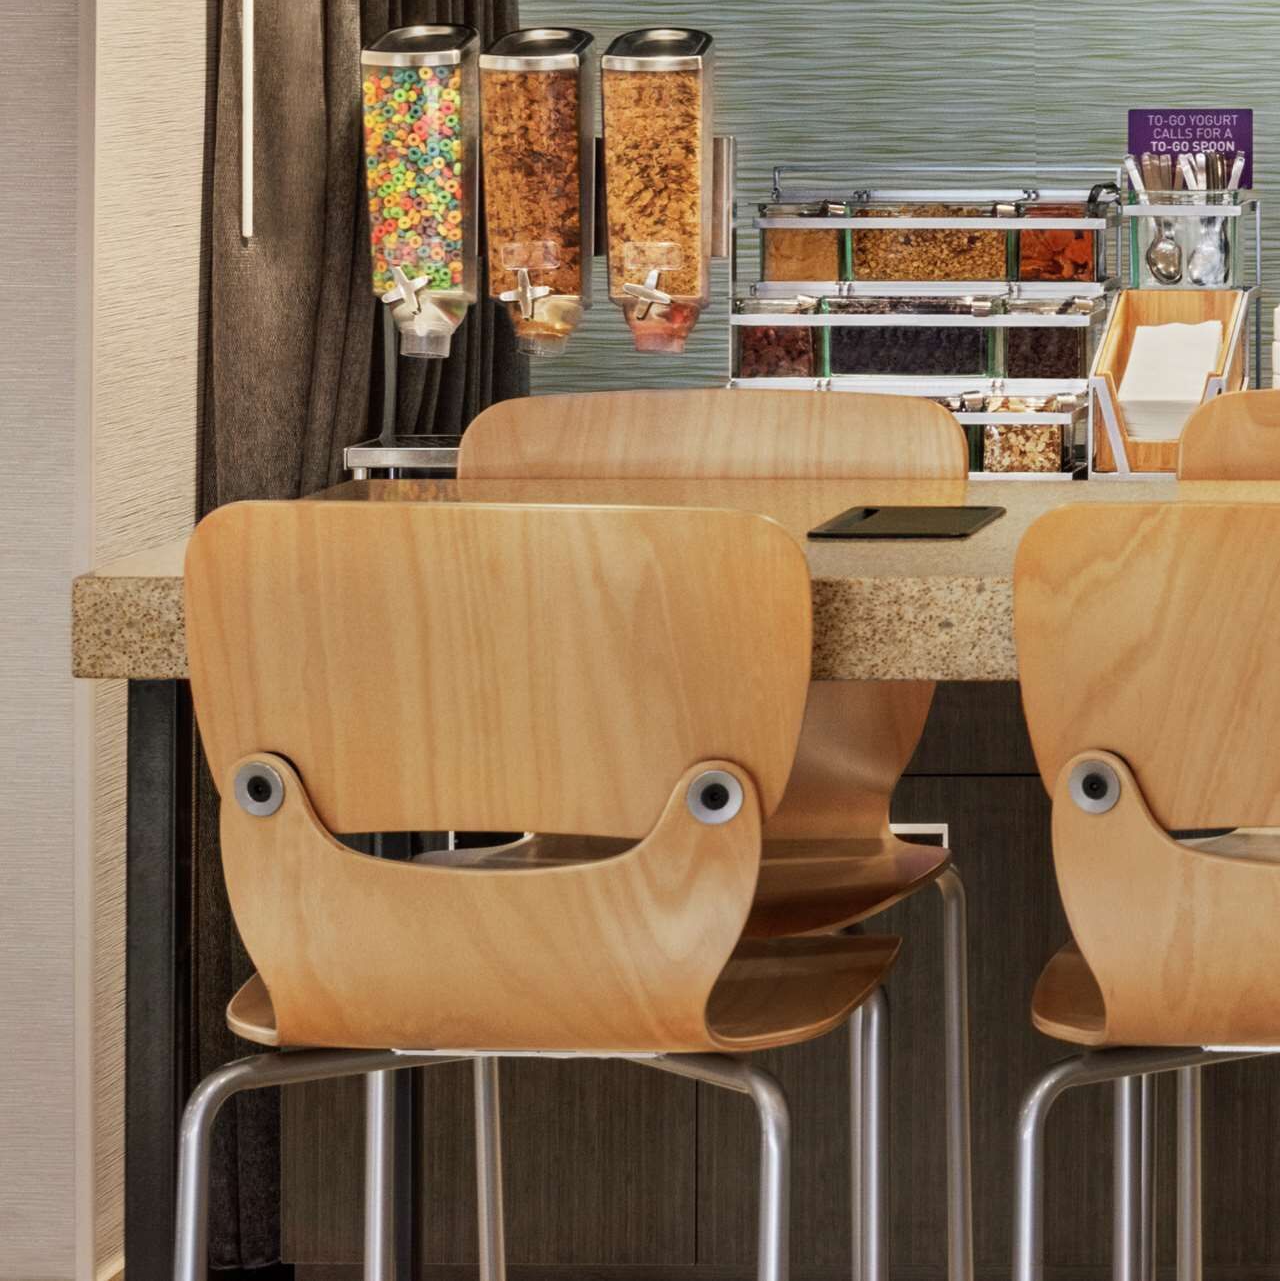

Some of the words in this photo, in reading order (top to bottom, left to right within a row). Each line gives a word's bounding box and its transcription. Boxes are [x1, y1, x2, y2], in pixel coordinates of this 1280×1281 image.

[1148, 114, 1186, 126] TO-GO
[1189, 114, 1238, 126] YOGURT
[1153, 128, 1193, 139] CALLS
[1196, 128, 1221, 139] FOR
[1223, 128, 1233, 139] A
[1151, 141, 1189, 152] TO-GO
[1192, 141, 1235, 152] SPOON
